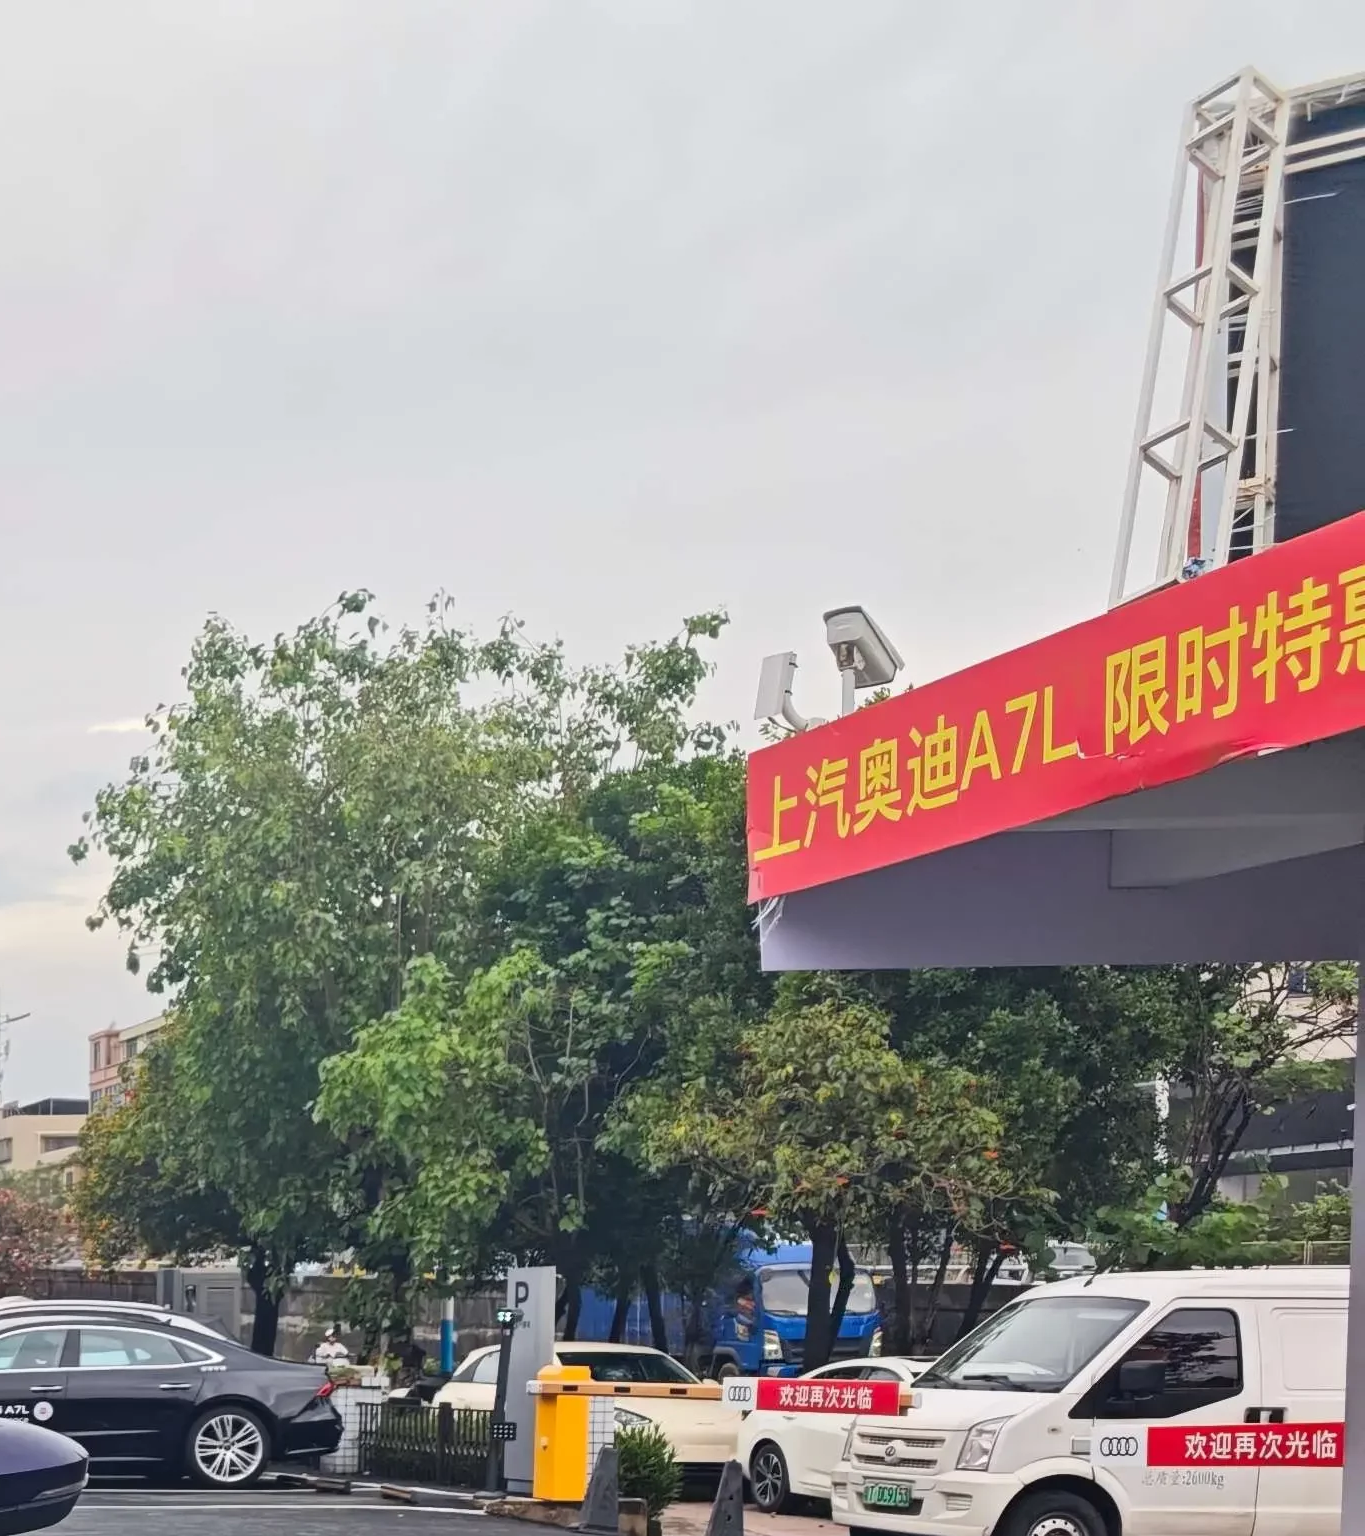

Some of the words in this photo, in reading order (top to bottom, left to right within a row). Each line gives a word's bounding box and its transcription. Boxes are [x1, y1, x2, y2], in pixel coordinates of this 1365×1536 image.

[753, 685, 1079, 862] 上汽奥迪A7L
[515, 1281, 529, 1309] P
[5, 1405, 29, 1415] A7L
[779, 1384, 873, 1409] 欢迎再次光临
[1184, 1429, 1338, 1460] 欢迎再次光临
